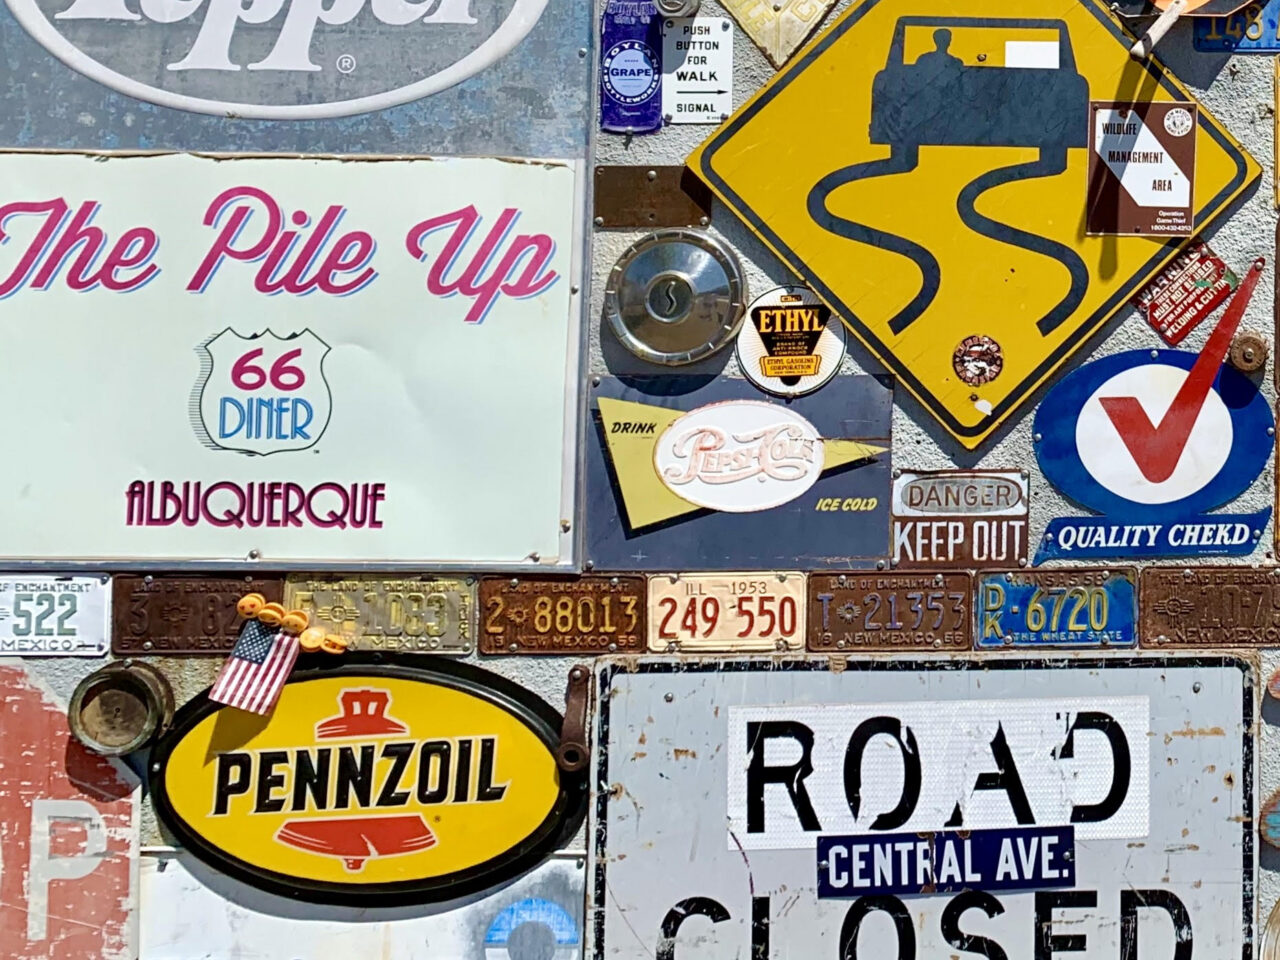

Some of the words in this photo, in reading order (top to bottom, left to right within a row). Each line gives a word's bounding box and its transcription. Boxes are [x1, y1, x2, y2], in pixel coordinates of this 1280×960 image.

[683, 25, 711, 36] PUSH
[675, 40, 720, 51] BUTTON
[610, 67, 652, 77] GRAPE
[687, 55, 707, 66] FOR
[676, 71, 718, 82] WALK
[676, 103, 717, 114] SIGNAL
[1102, 122, 1138, 135] WILDLIFE
[1107, 150, 1164, 165] MANAGEMENT
[1151, 179, 1173, 192] AREA
[0, 197, 162, 297] The
[186, 186, 380, 297] Pile
[405, 204, 560, 325] Up
[759, 309, 824, 334] ETHYL
[231, 347, 306, 392] 66
[218, 396, 315, 441] DINER
[610, 421, 658, 436] DRINK
[124, 480, 386, 529] ALBUQUERQUE
[815, 497, 840, 512] ICE
[841, 496, 878, 512] COLD
[908, 483, 1012, 508] DANGER
[894, 521, 964, 562] KEEP
[972, 519, 1025, 561] OUT
[1057, 523, 1163, 549] QUALITY
[657, 596, 720, 640] 249
[735, 595, 798, 639] 550
[212, 737, 509, 815] PENNZOIL
[746, 715, 1132, 836] ROAD
[827, 835, 981, 891] CENTRAL
[996, 834, 1069, 883] AVE.
